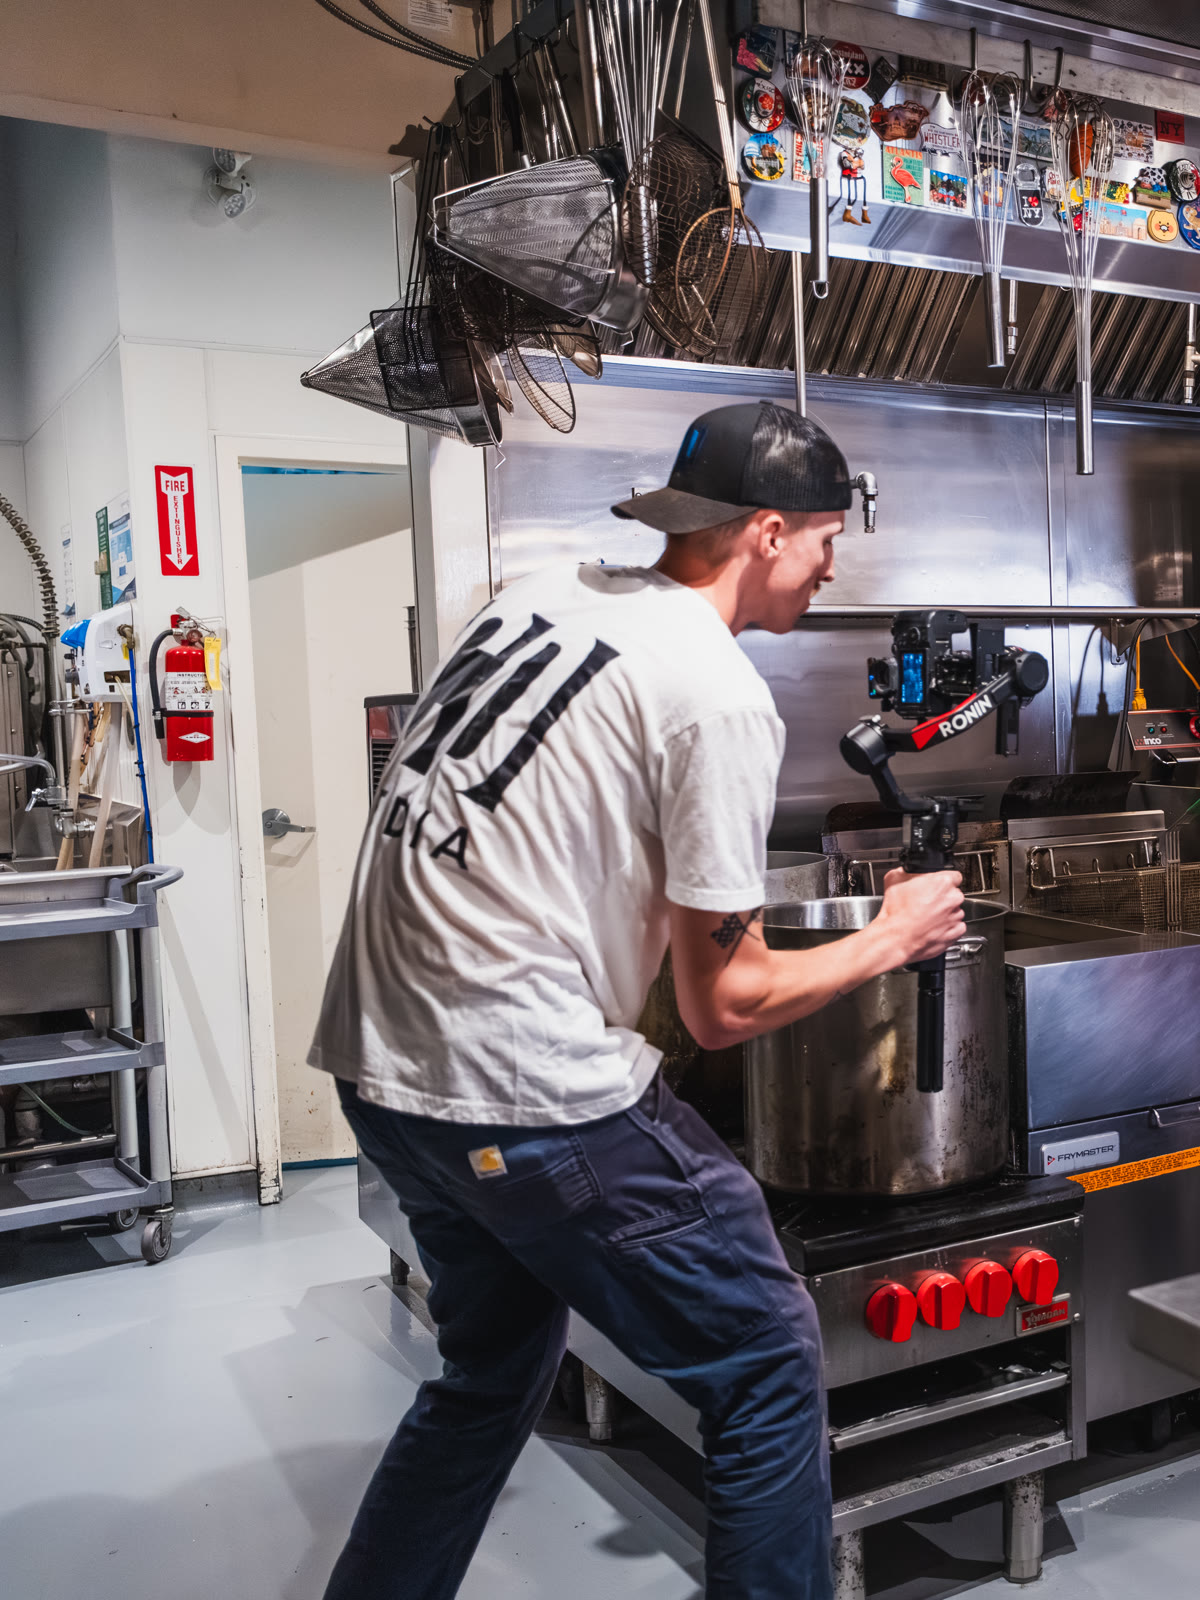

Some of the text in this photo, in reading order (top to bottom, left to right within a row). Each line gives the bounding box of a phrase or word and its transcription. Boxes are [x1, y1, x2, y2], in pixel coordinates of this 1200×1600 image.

[1160, 121, 1182, 136] NY
[924, 132, 961, 148] WHISTLER
[1022, 196, 1029, 207] I
[1022, 207, 1041, 219] NY
[165, 480, 185, 492] FIRE
[173, 495, 183, 565] EXTINGUISHER
[938, 694, 993, 738] RONIN
[379, 789, 468, 870] DIA
[1057, 1144, 1115, 1162] FRYMASTER
